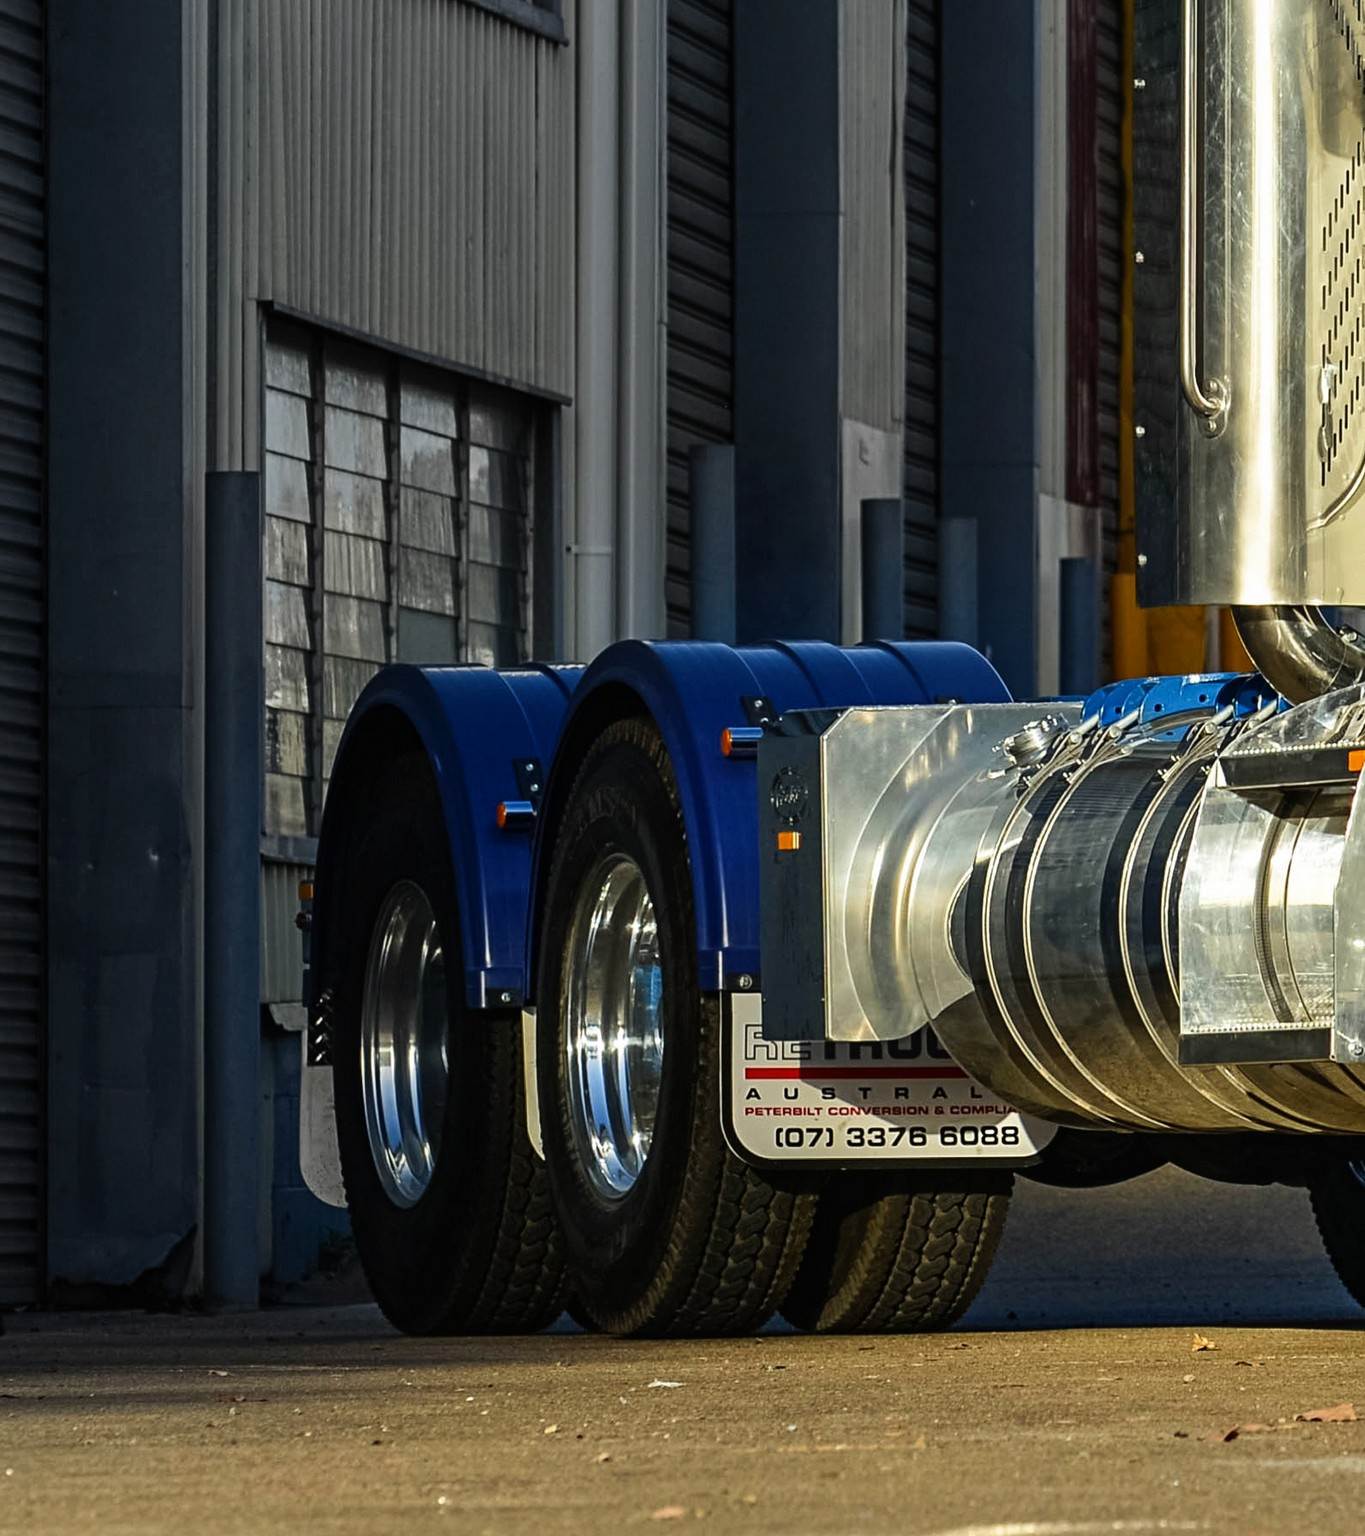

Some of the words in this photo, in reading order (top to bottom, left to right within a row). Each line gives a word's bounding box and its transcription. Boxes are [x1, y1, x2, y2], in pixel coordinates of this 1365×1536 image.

[745, 1106, 823, 1116] PETERBILT
[828, 1106, 929, 1116] CONVERSION
[934, 1105, 945, 1116] &
[775, 1127, 834, 1148] (07)
[846, 1126, 927, 1148] 3376
[940, 1125, 1020, 1146] 6088
